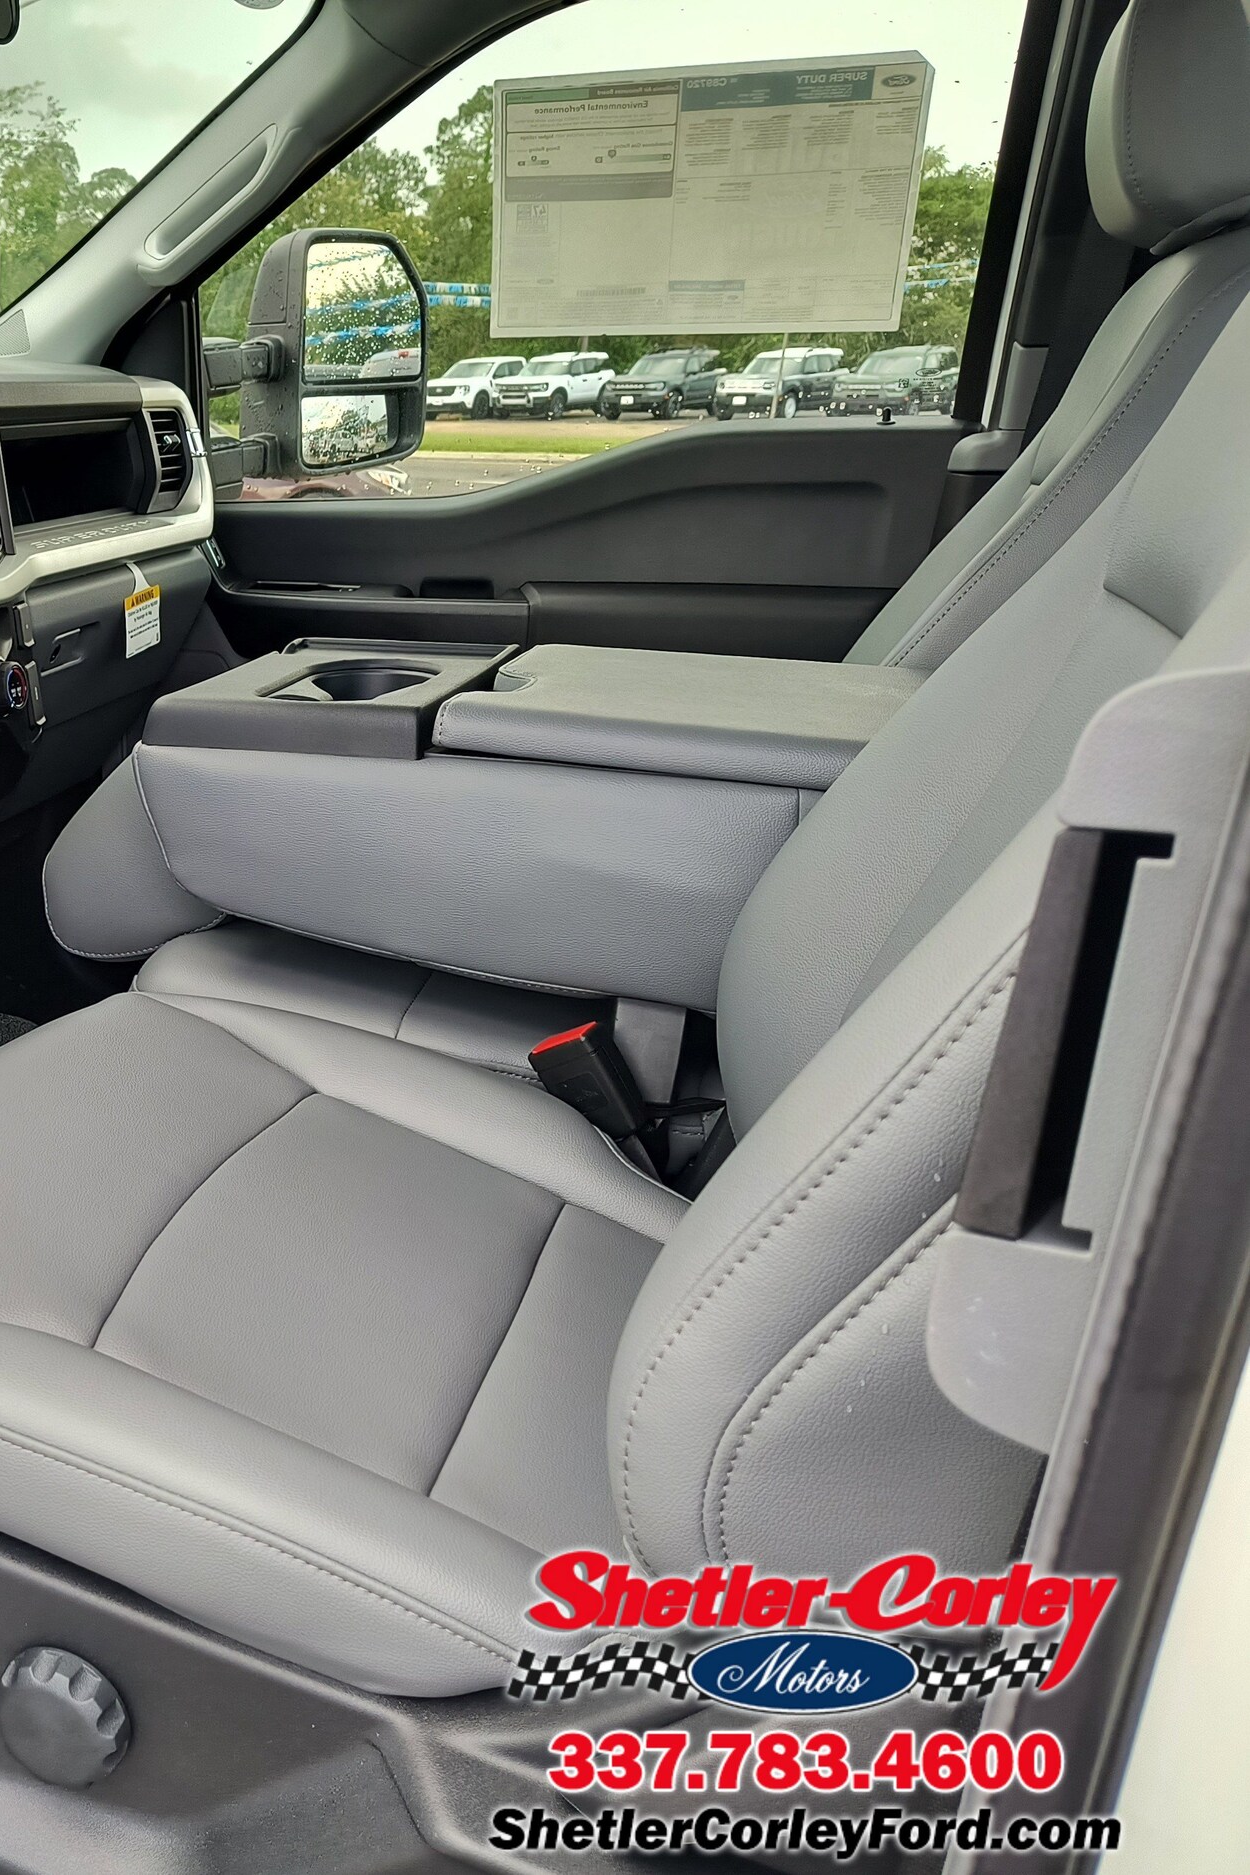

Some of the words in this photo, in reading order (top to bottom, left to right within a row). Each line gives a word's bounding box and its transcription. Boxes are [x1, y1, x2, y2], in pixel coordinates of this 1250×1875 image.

[31, 530, 106, 549] SUPER
[100, 520, 150, 534] DUTY
[134, 589, 155, 604] WARNING
